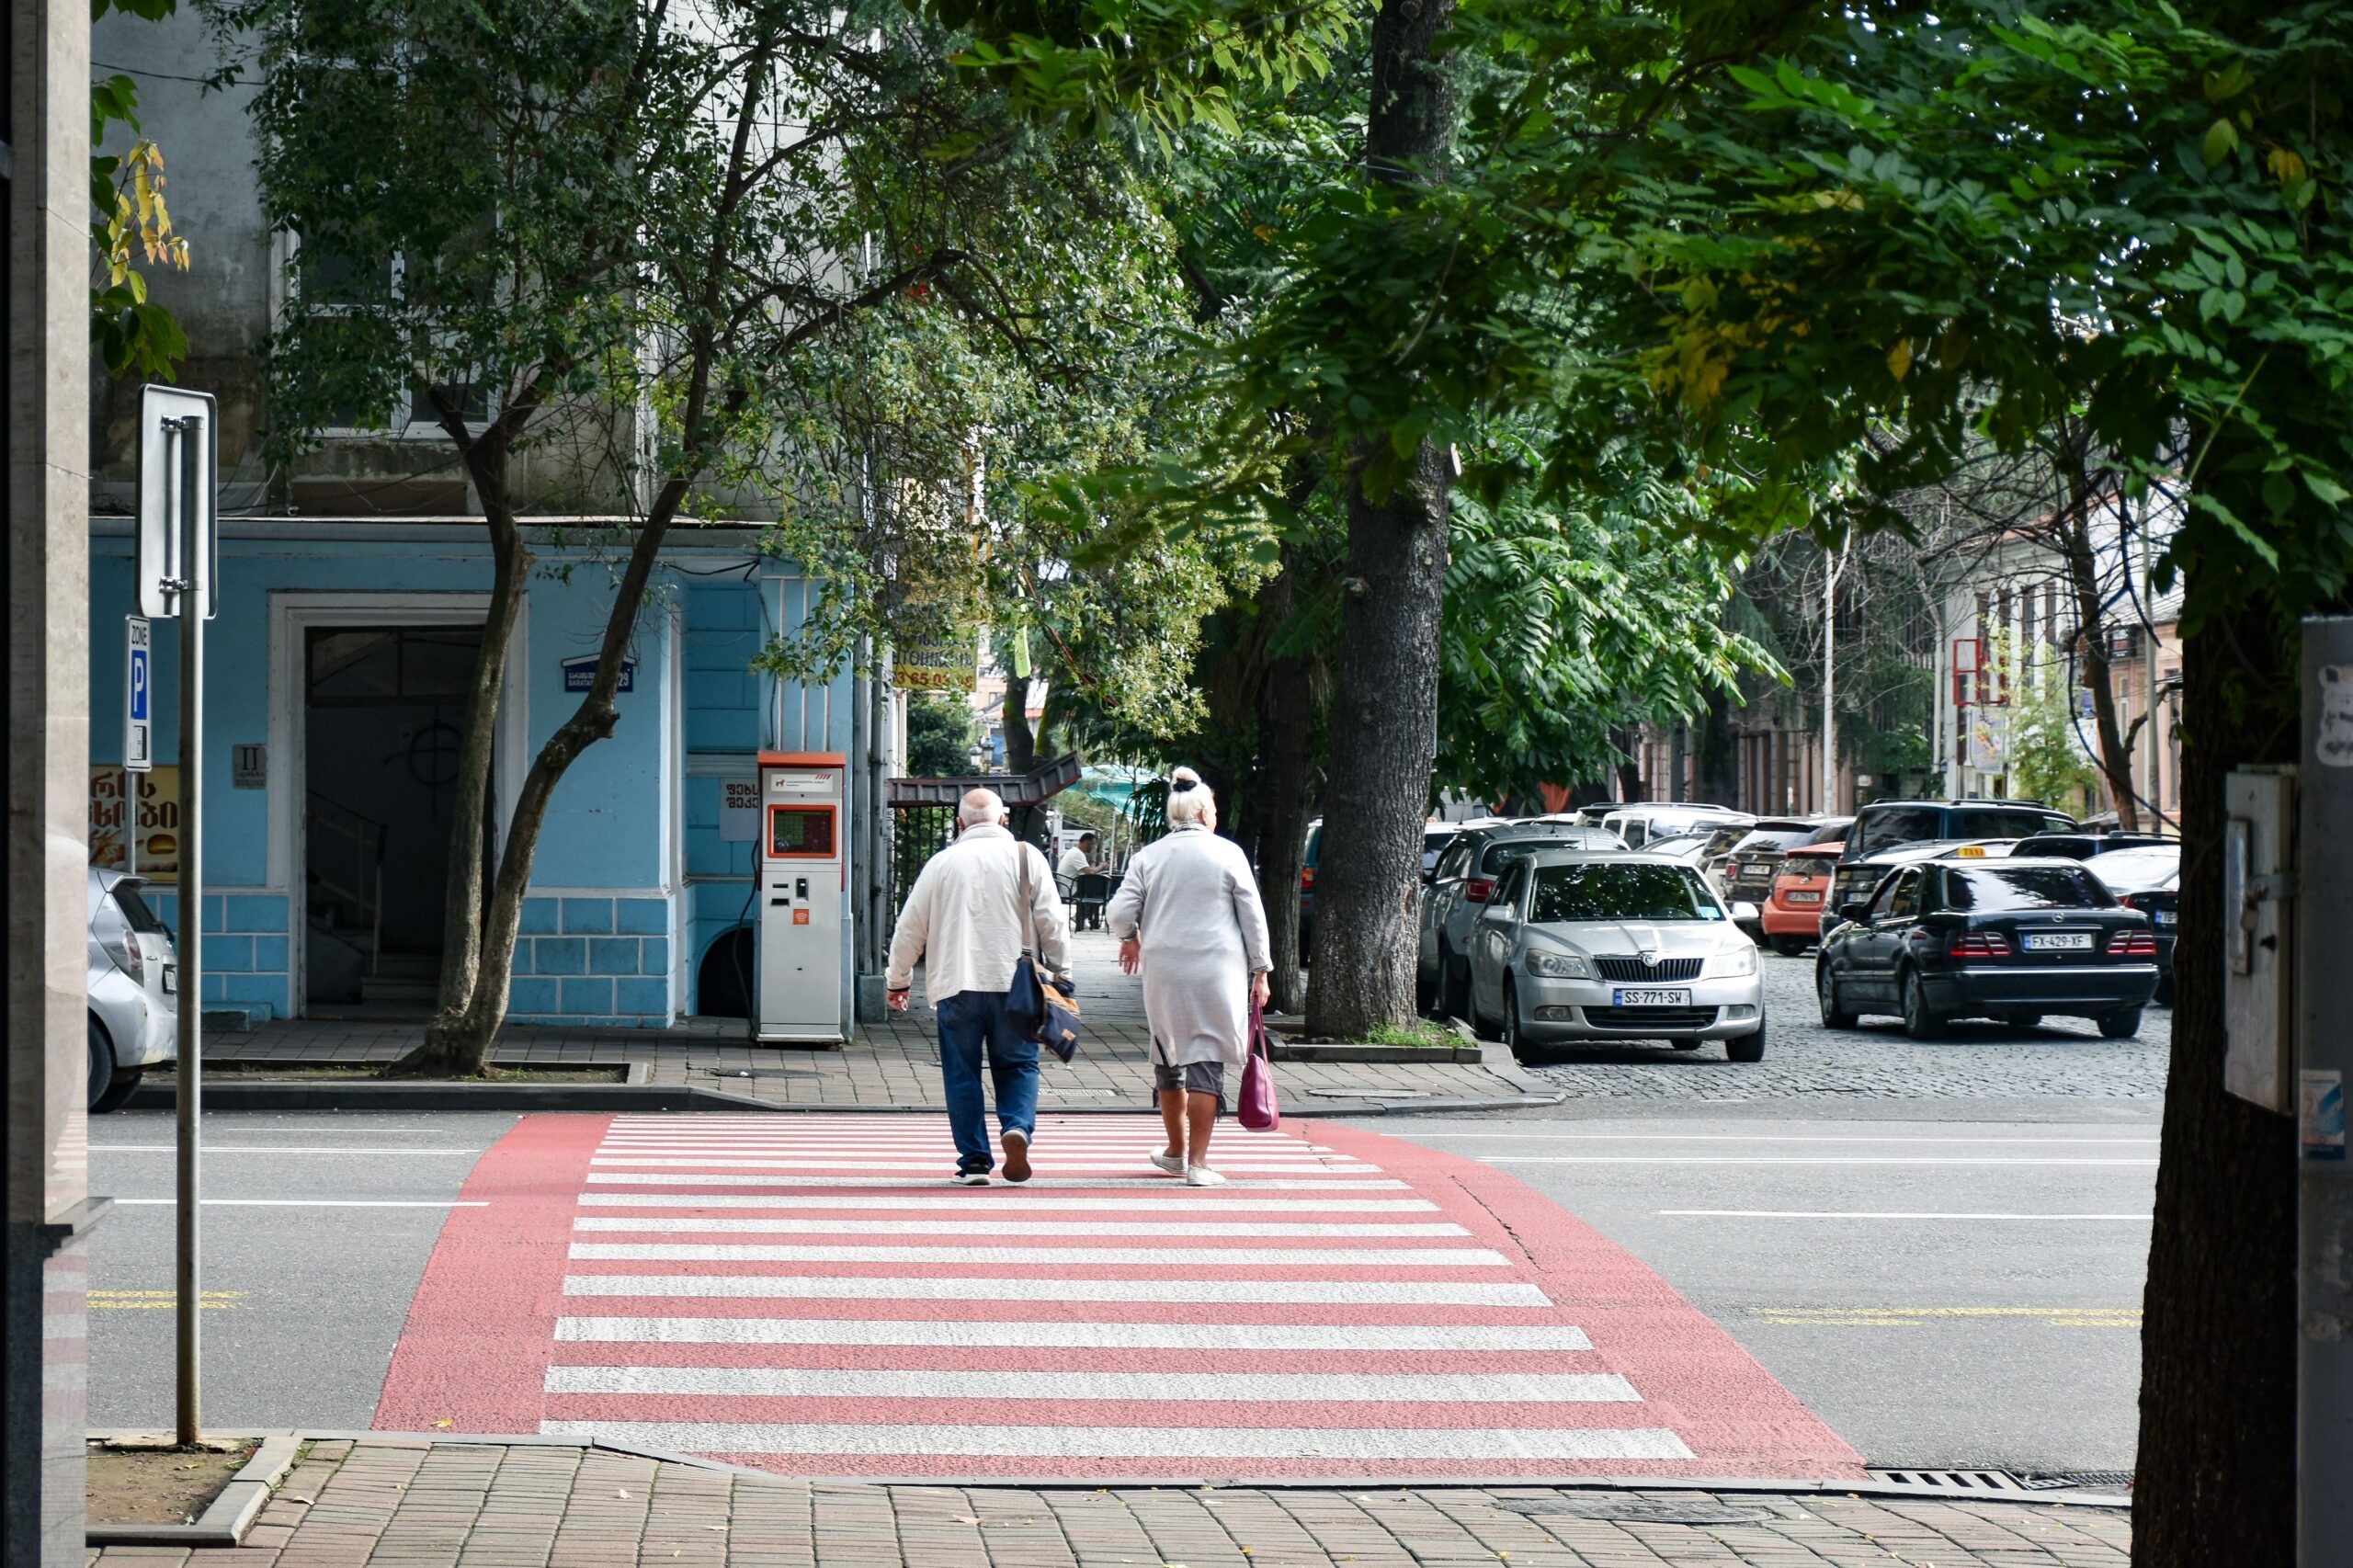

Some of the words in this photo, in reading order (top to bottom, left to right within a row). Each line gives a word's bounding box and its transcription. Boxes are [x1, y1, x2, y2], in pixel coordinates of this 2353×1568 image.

[131, 625, 147, 645] ZONE
[133, 657, 144, 712] P
[618, 672, 630, 687] 29
[2032, 936, 2084, 947] FX-429-XF
[1624, 992, 1682, 1004] SS-771-SW
